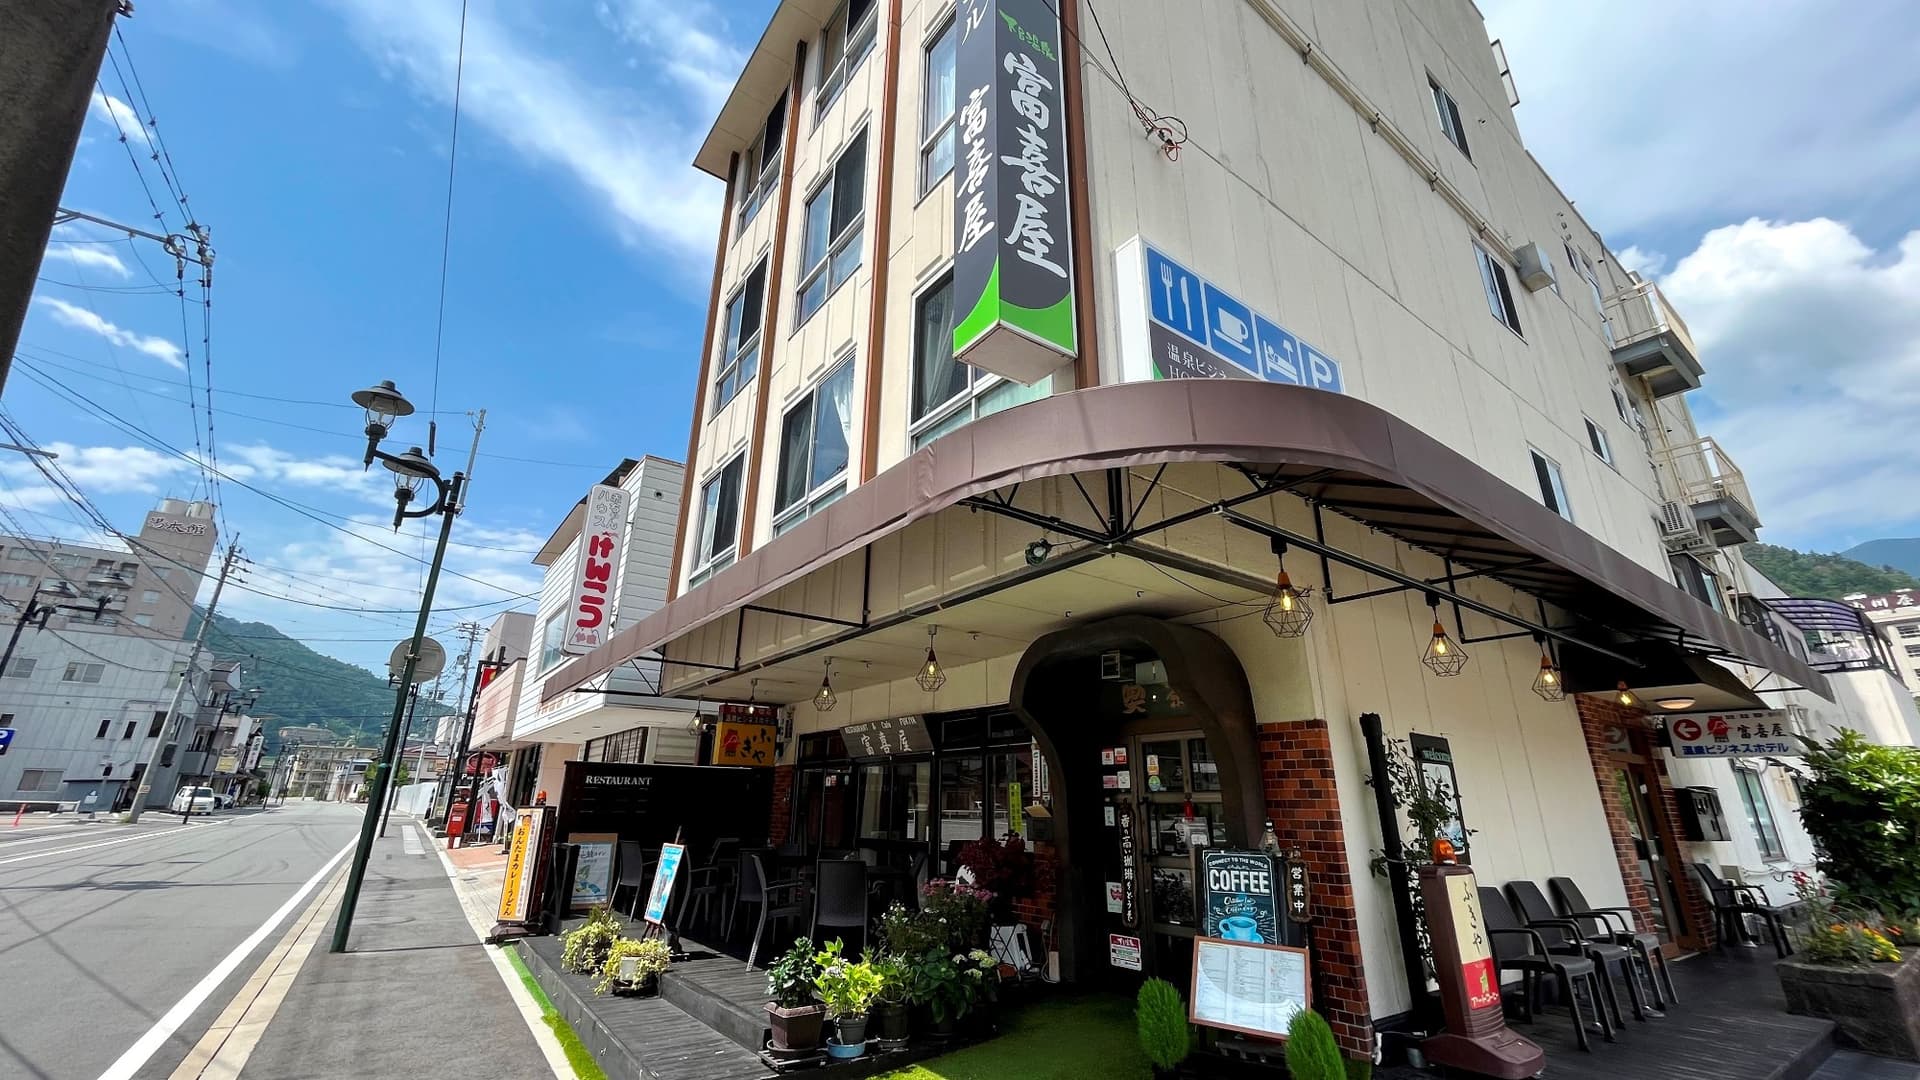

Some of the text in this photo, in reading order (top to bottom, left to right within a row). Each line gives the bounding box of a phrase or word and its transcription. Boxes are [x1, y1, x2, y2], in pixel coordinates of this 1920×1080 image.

[957, 83, 997, 254] 富喜屋
[1001, 51, 1068, 279] 富喜屋
[1308, 352, 1332, 388] P
[584, 774, 653, 787] RESTAURANT
[1209, 869, 1270, 894] COFFEE
[1290, 866, 1305, 914] 営業中
